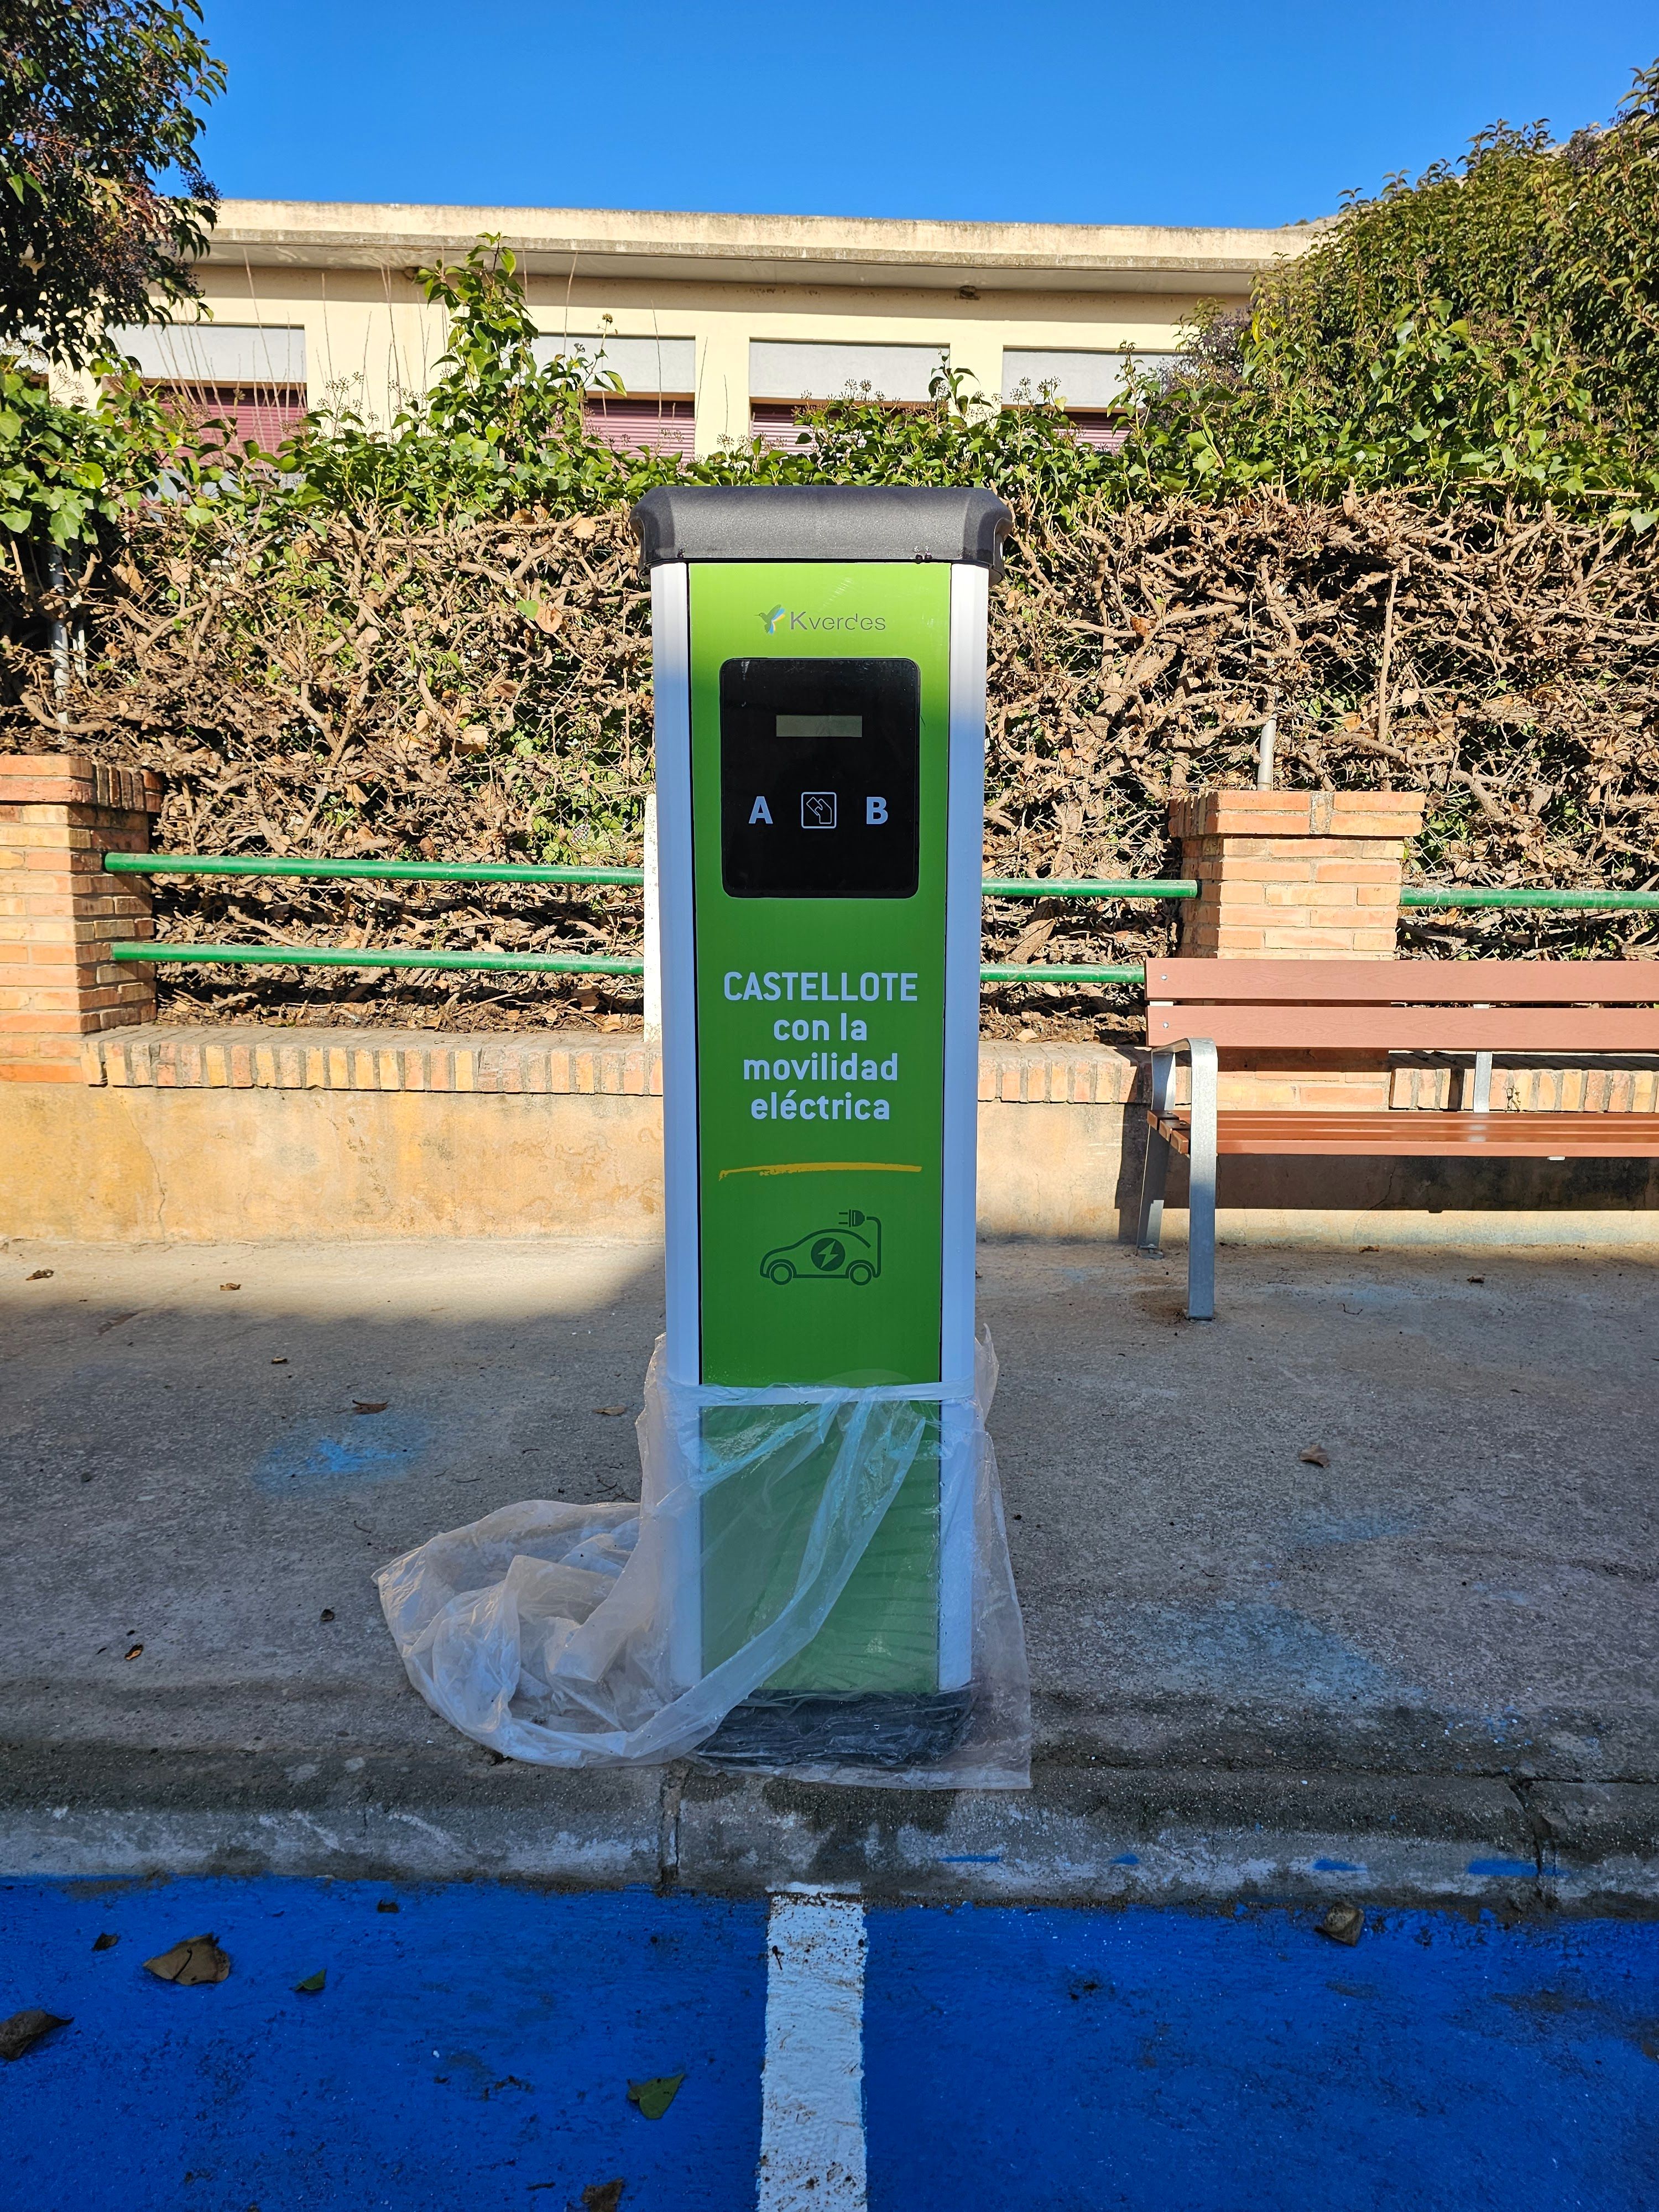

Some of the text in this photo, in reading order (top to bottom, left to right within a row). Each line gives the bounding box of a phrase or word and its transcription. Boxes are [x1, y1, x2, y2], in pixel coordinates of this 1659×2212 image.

[790, 611, 886, 630] Kverdes
[748, 796, 773, 824] A
[866, 796, 888, 825] B
[724, 971, 918, 1001] CASTELLOTE
[774, 1013, 867, 1041] con la
[743, 1052, 898, 1081] movilidad
[751, 1089, 890, 1120] eléctrica
